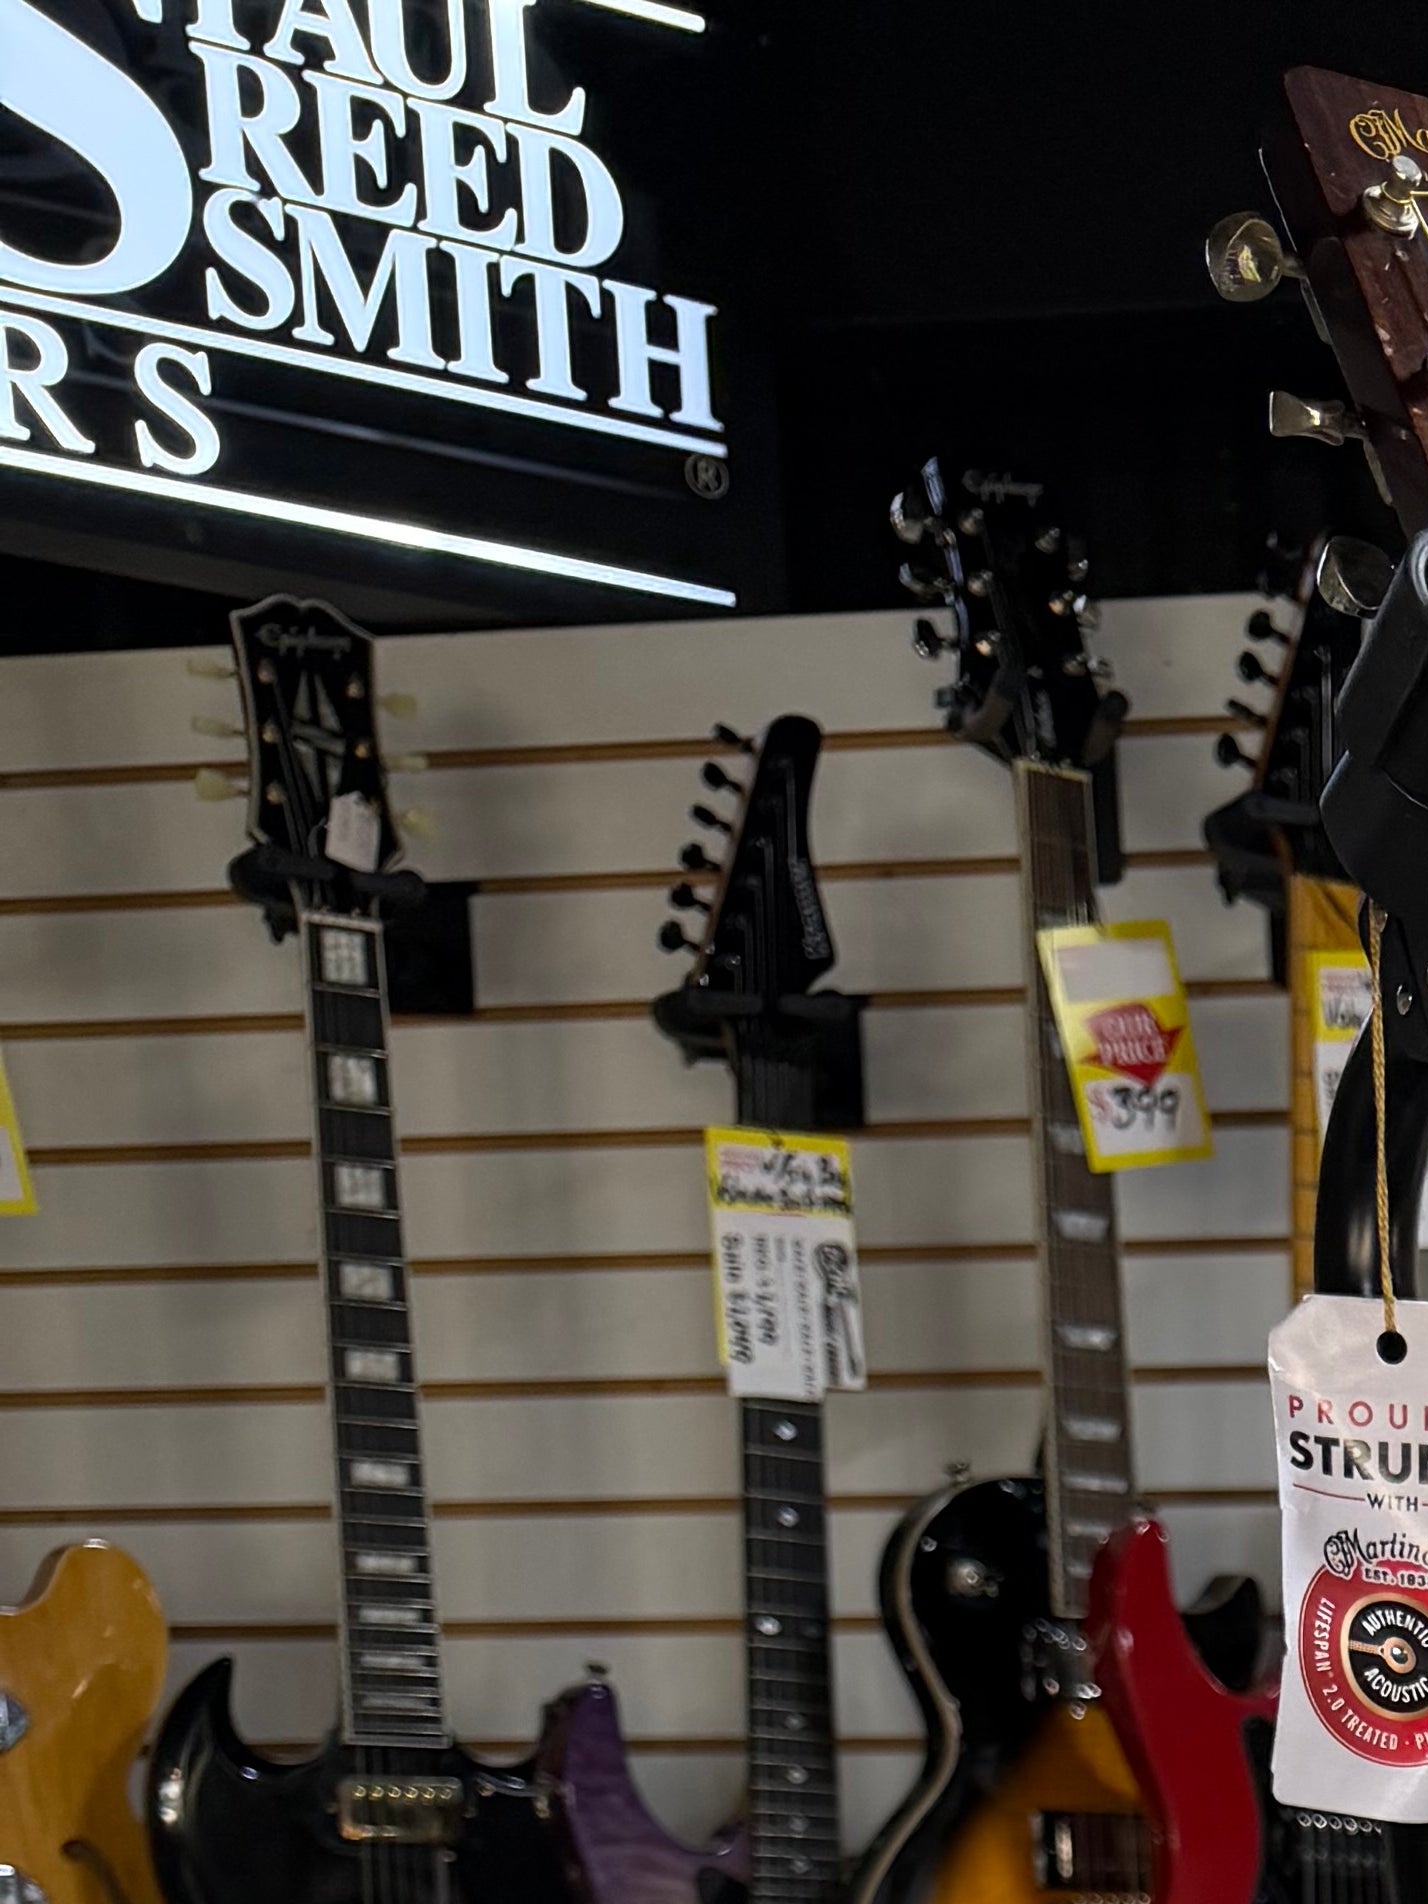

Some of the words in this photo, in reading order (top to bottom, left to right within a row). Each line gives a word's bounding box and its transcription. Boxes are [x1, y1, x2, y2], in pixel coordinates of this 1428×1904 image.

[190, 42, 624, 269] REED
[203, 188, 724, 432] SMITH
[1367, 1493, 1418, 1512] WITH
[1323, 1684, 1343, 1711] 2.0
[1341, 1709, 1398, 1750] TREATED
